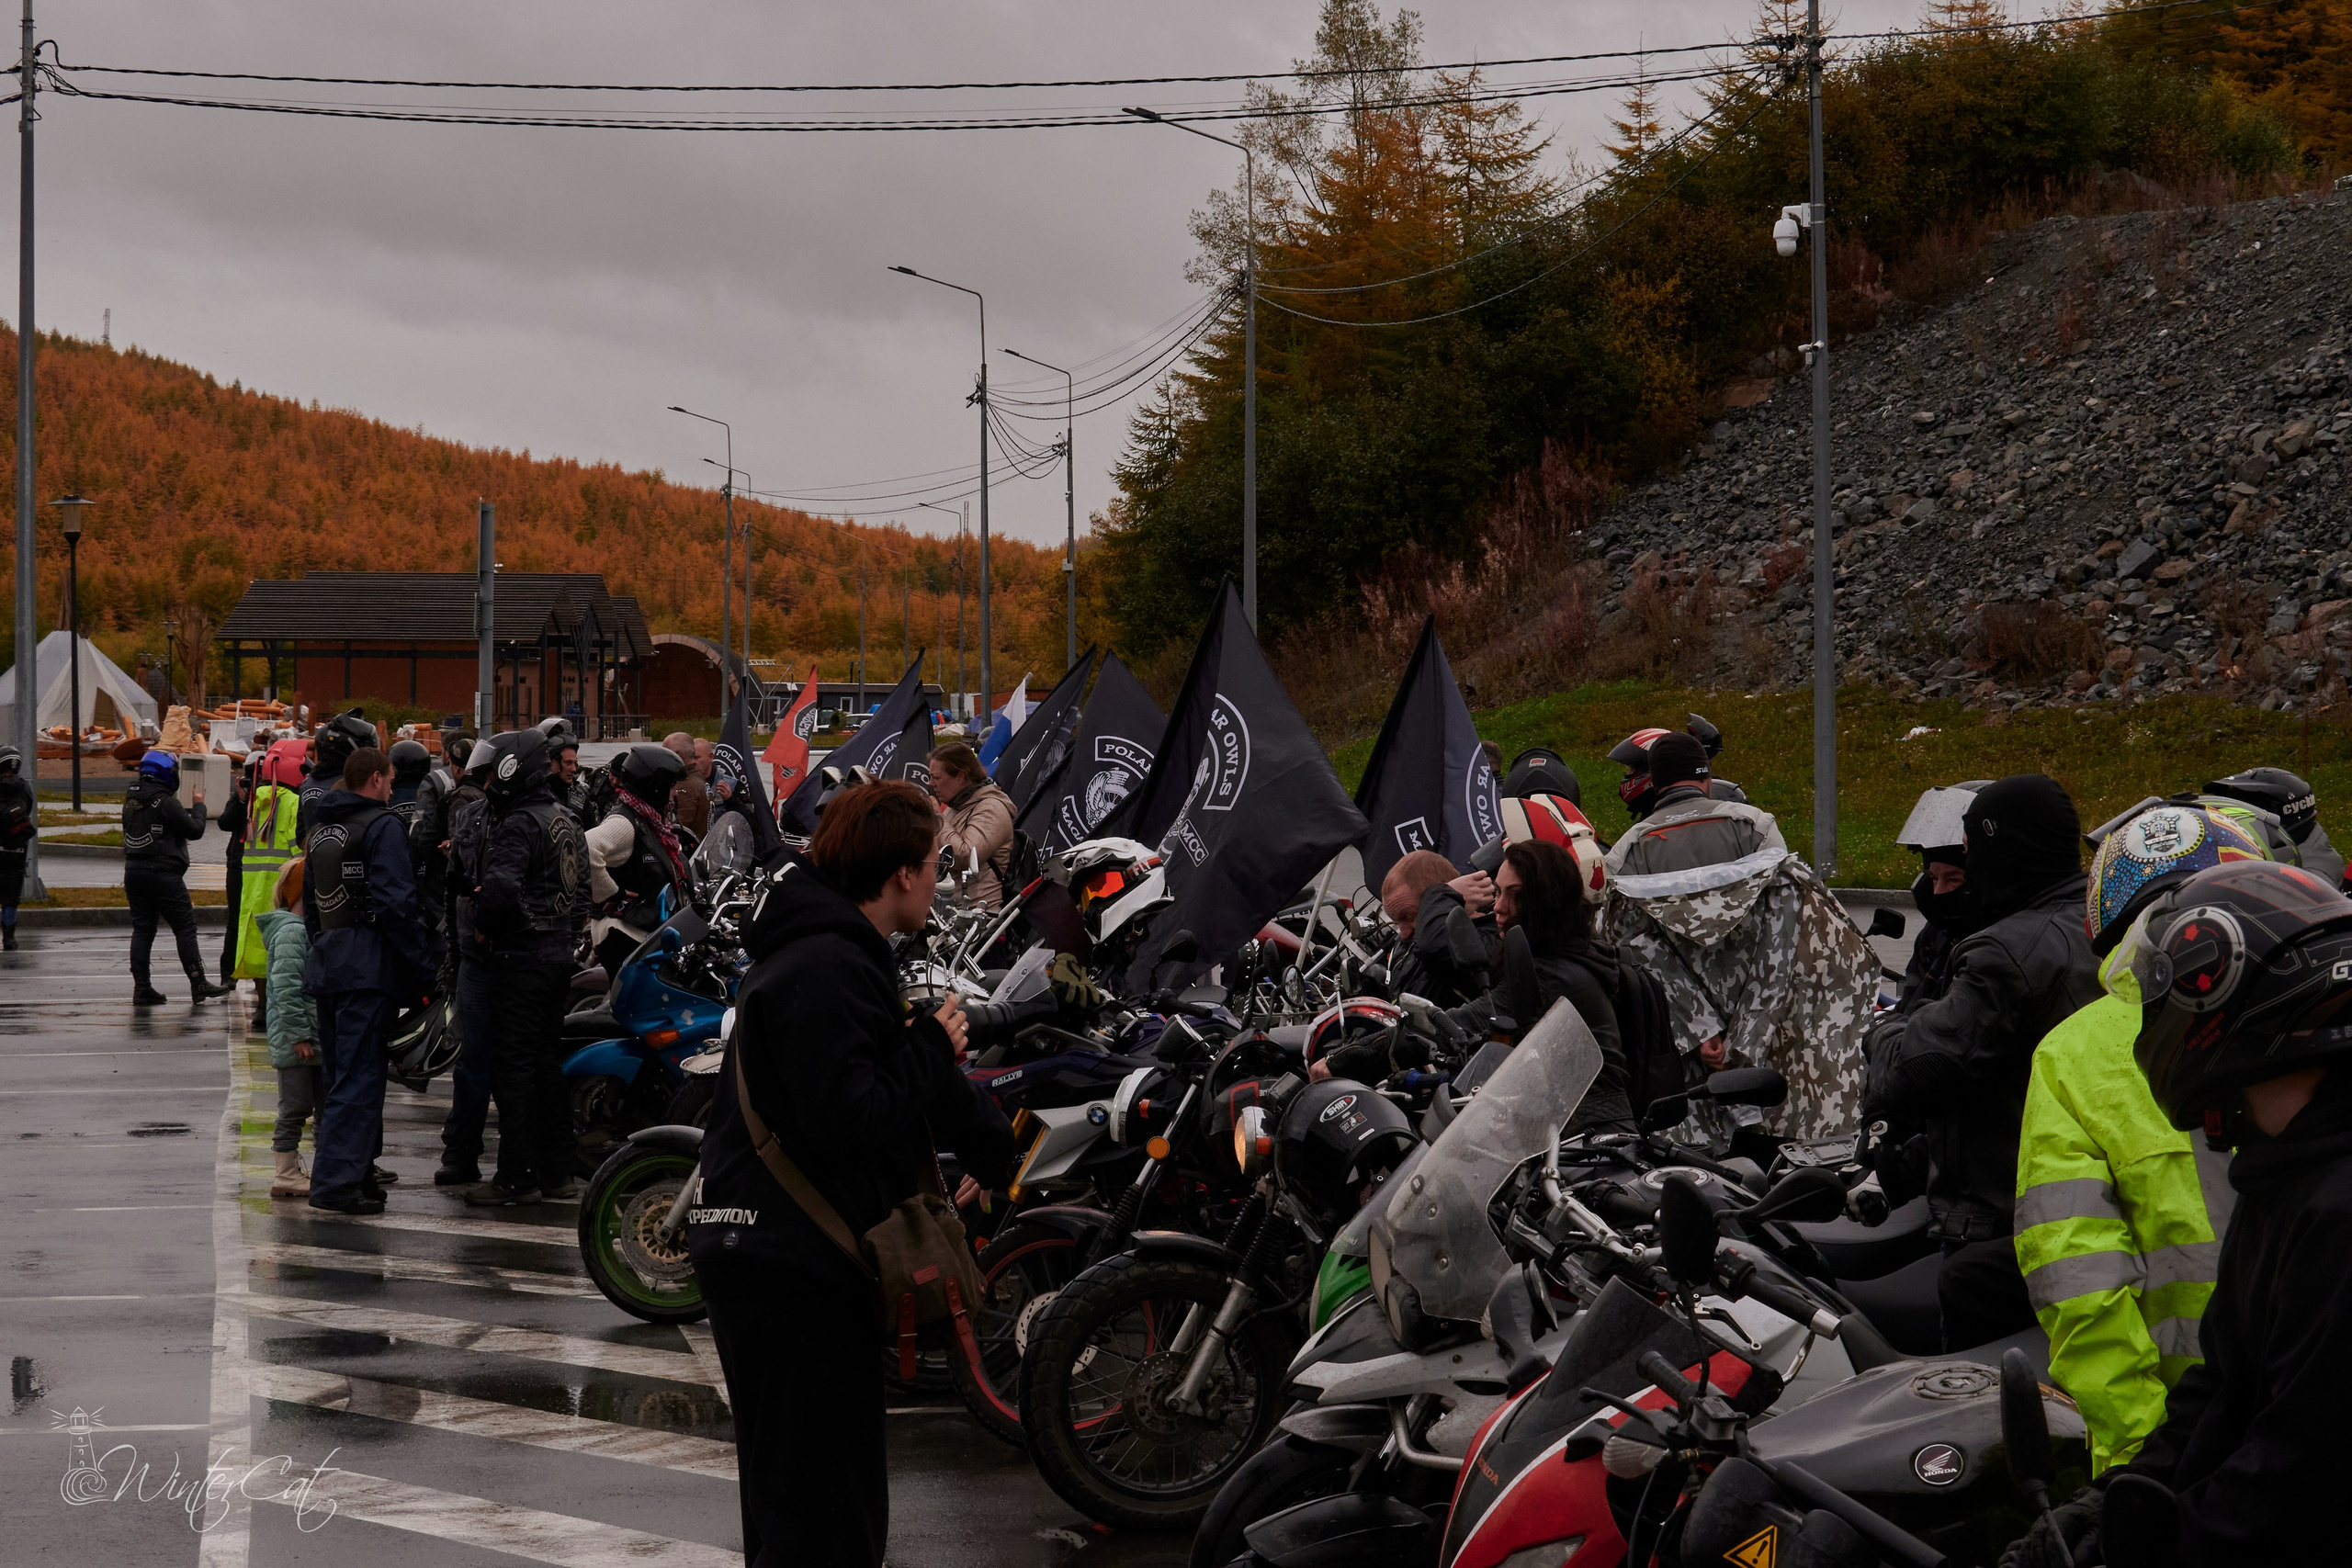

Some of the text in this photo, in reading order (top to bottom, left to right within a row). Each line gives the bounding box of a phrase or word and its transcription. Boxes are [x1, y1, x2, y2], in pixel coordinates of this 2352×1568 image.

[717, 749, 742, 773] POLAR
[1219, 732, 1238, 796] OWLS
[1181, 824, 1206, 863] MCC
[343, 866, 363, 874] MCC
[2332, 959, 2352, 981] G
[1924, 1467, 1958, 1477] HONDA
